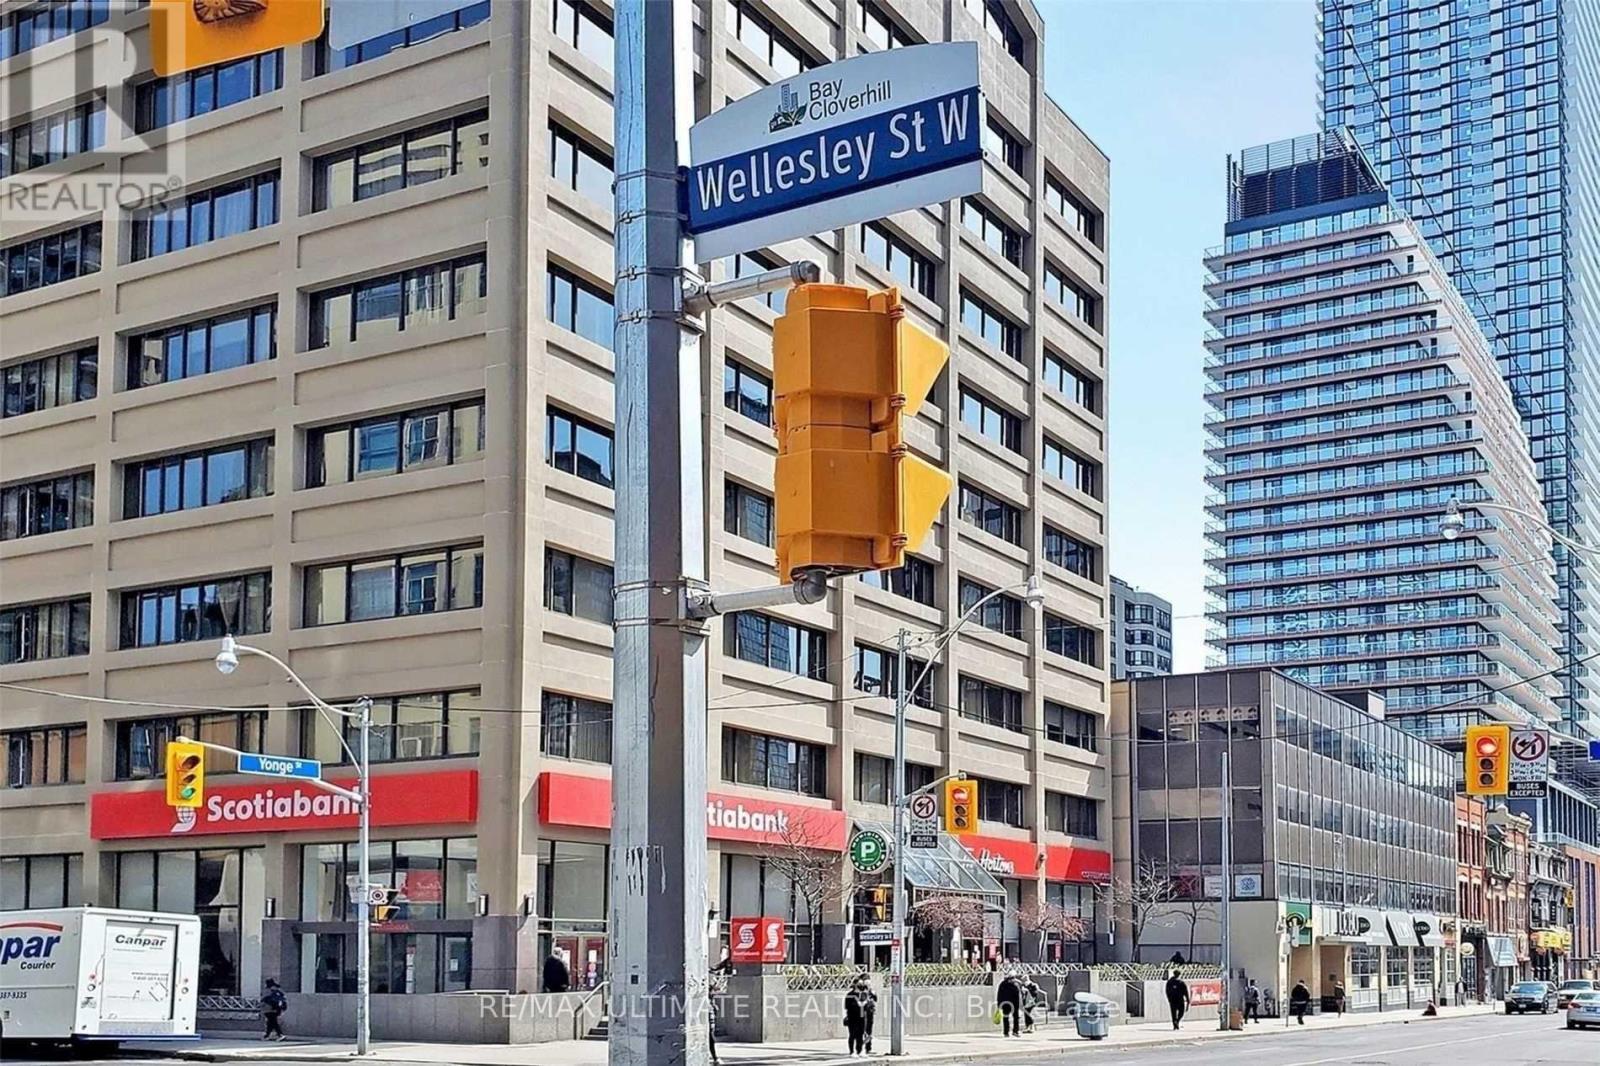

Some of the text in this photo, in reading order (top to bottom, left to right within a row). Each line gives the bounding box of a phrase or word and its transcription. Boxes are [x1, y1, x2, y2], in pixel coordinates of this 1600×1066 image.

[809, 79, 843, 101] Bay
[809, 80, 892, 121] Cloverhill
[696, 94, 970, 212] Wellesley St W
[259, 757, 294, 775] Yonge
[861, 841, 876, 858] P
[0, 936, 61, 965] par
[115, 934, 167, 947] Canpar
[20, 960, 56, 970] Courier
